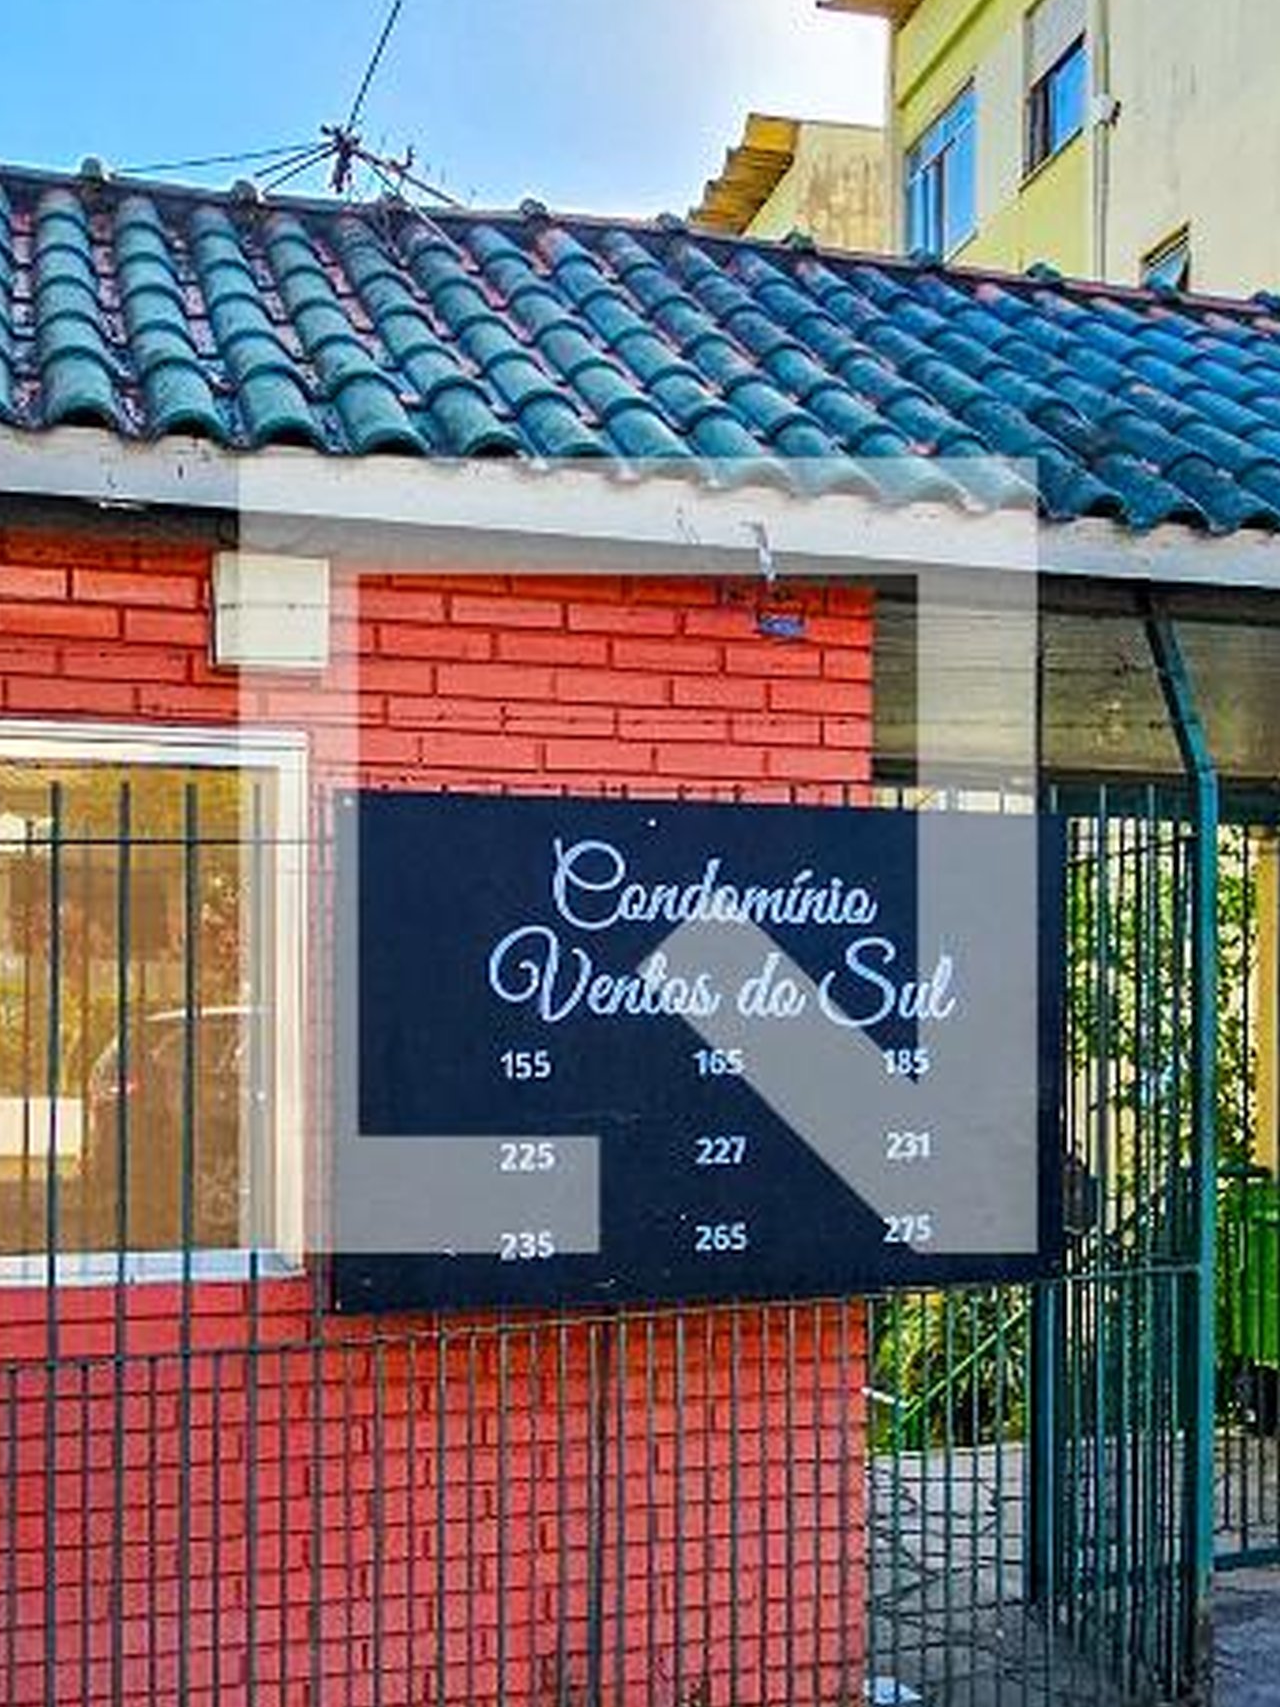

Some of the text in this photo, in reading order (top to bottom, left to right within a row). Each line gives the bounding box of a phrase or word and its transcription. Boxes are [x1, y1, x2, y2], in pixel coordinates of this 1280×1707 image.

[552, 838, 877, 930] Condomínio
[488, 925, 957, 1027] Ventos do Sul
[499, 1050, 552, 1081] 155
[693, 1049, 744, 1077] 165
[884, 1047, 930, 1076] 185
[499, 1144, 556, 1171] 225
[694, 1137, 746, 1165] 227
[885, 1132, 931, 1160] 231
[694, 1224, 747, 1252] 265
[883, 1216, 932, 1244] 275
[499, 1232, 555, 1261] 235
